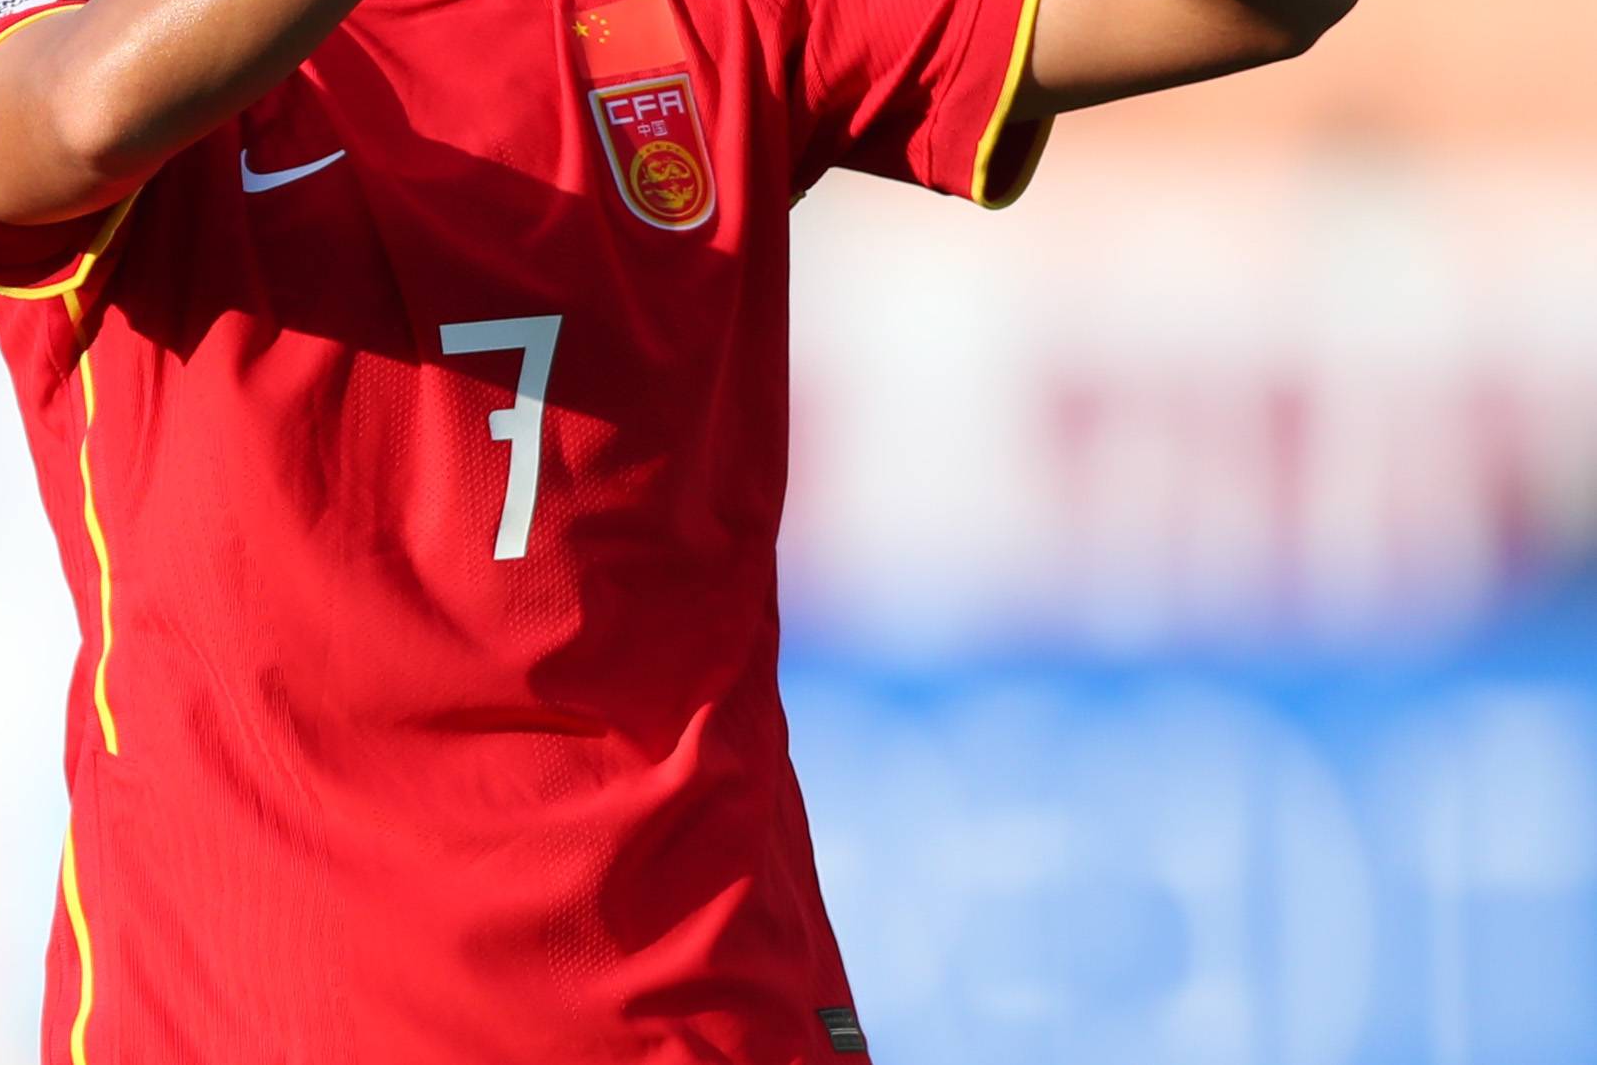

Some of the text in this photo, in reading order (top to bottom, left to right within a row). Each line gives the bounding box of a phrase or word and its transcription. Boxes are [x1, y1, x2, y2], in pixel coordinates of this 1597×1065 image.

[605, 89, 686, 125] CFA
[637, 119, 668, 137] 中国
[439, 314, 563, 561] 7
